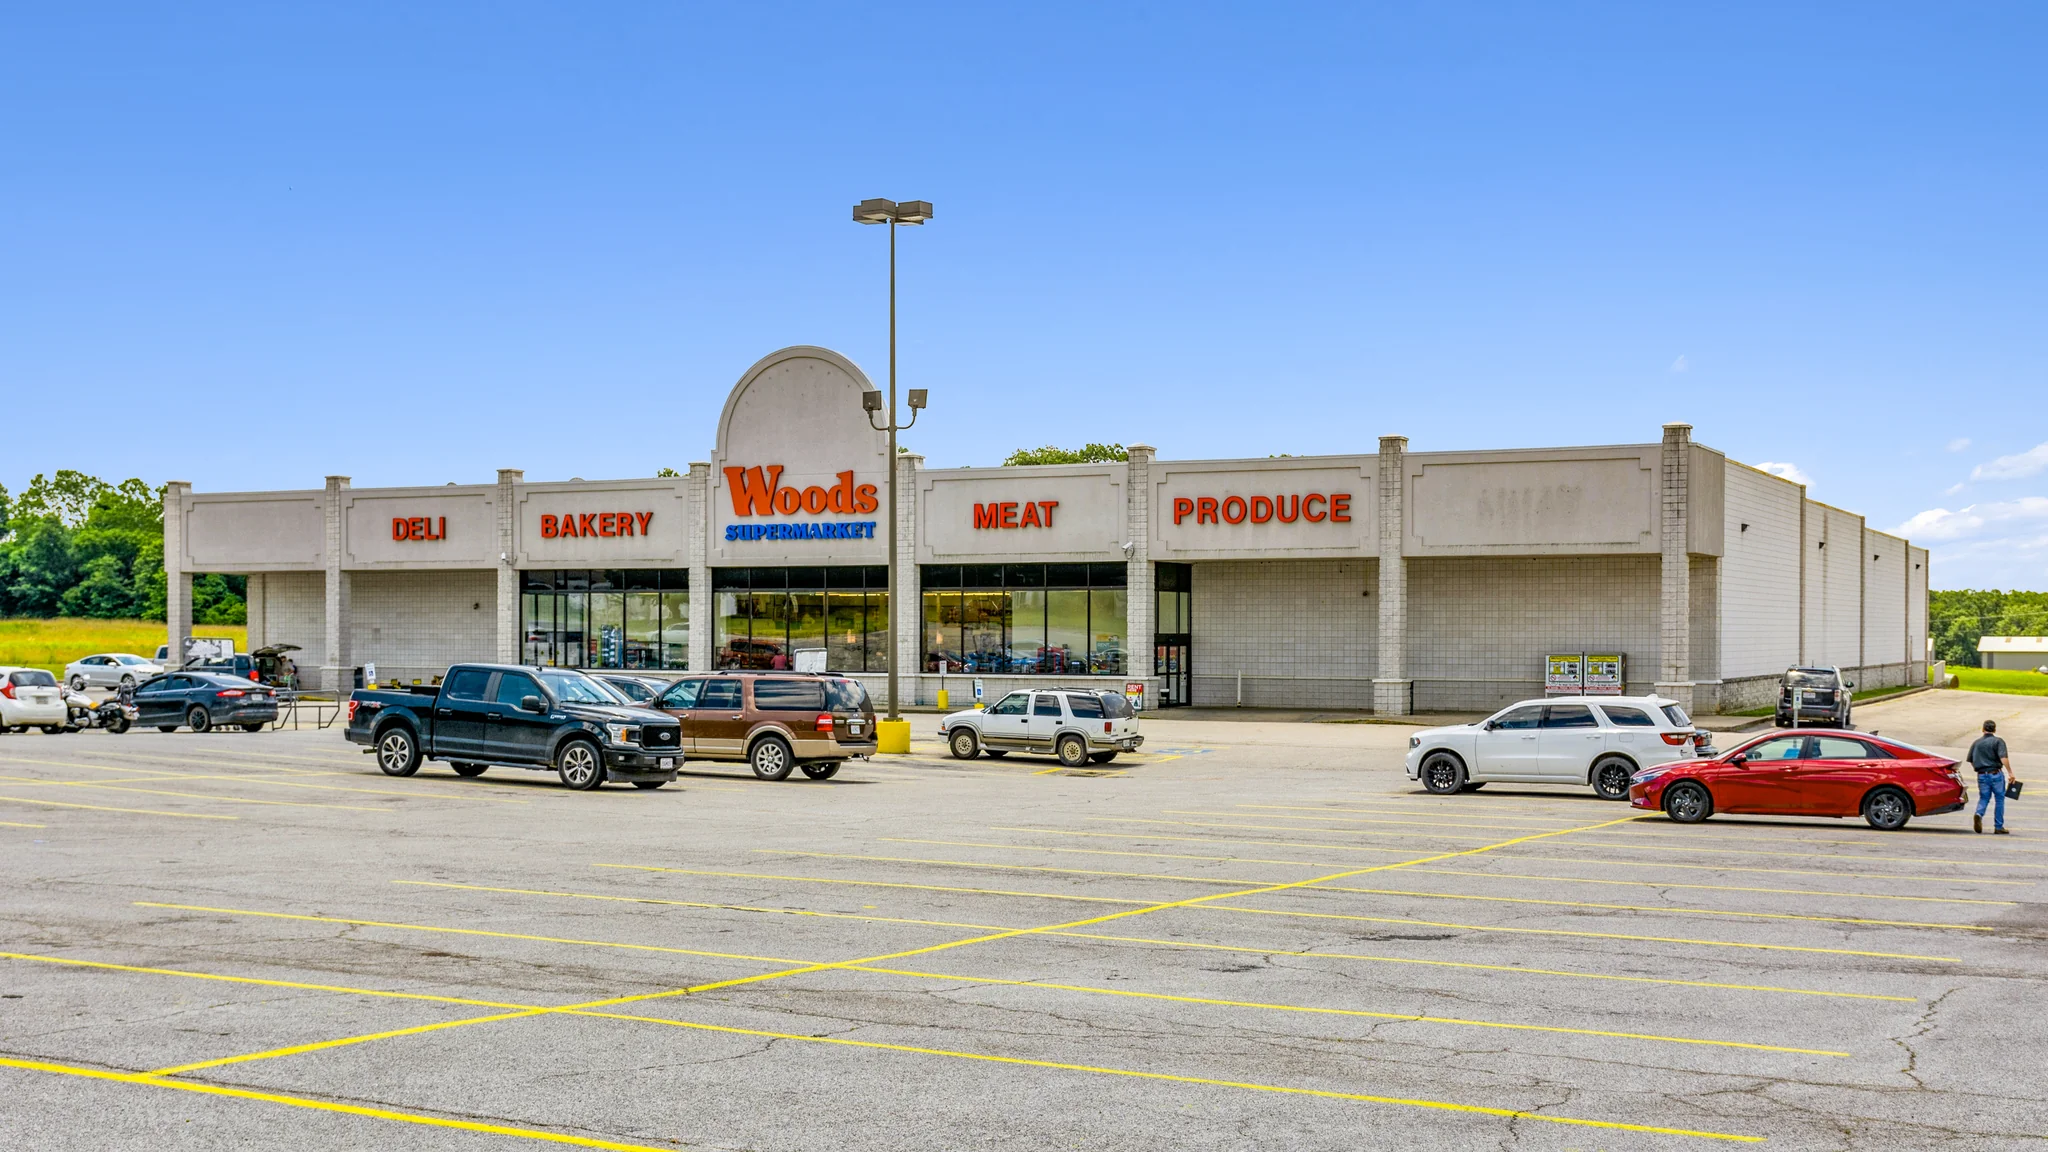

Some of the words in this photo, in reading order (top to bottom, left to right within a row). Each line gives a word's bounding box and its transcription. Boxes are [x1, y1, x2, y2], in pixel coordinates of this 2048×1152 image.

[723, 465, 878, 516] Woods
[973, 500, 1058, 529] MEAT
[1173, 493, 1351, 525] PRODUCE
[392, 517, 446, 541] DELI
[541, 511, 653, 539] BAKERY
[725, 520, 877, 542] SUPERMARKET
